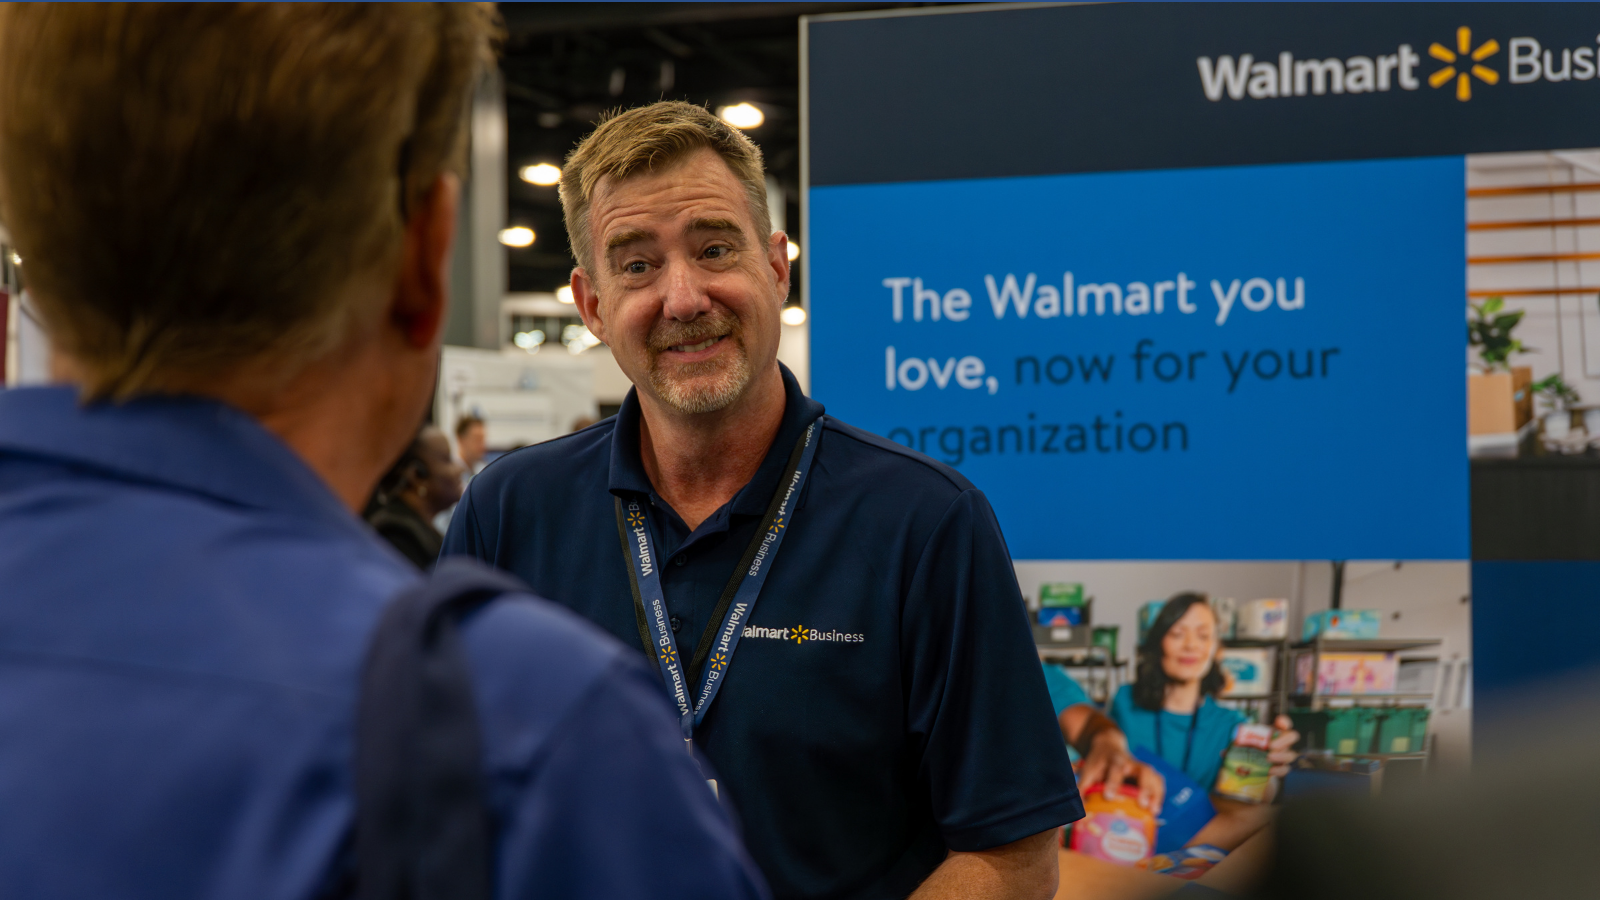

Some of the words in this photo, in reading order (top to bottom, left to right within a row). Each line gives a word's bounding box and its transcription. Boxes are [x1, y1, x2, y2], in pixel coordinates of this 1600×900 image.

[1197, 44, 1420, 101] Walmart
[882, 277, 972, 323] The
[984, 271, 1197, 320] Walmart
[1210, 276, 1306, 326] you
[885, 346, 999, 395] love,
[1014, 352, 1115, 386] now
[1130, 338, 1207, 384] for
[1222, 346, 1340, 395] your
[887, 410, 1189, 467] organization
[633, 526, 653, 577] Walmart
[748, 532, 777, 577] Business
[652, 599, 670, 647] Business
[717, 602, 748, 653] Walmart
[741, 625, 790, 640] almart
[809, 629, 865, 642] Business
[667, 663, 689, 716] Walmart
